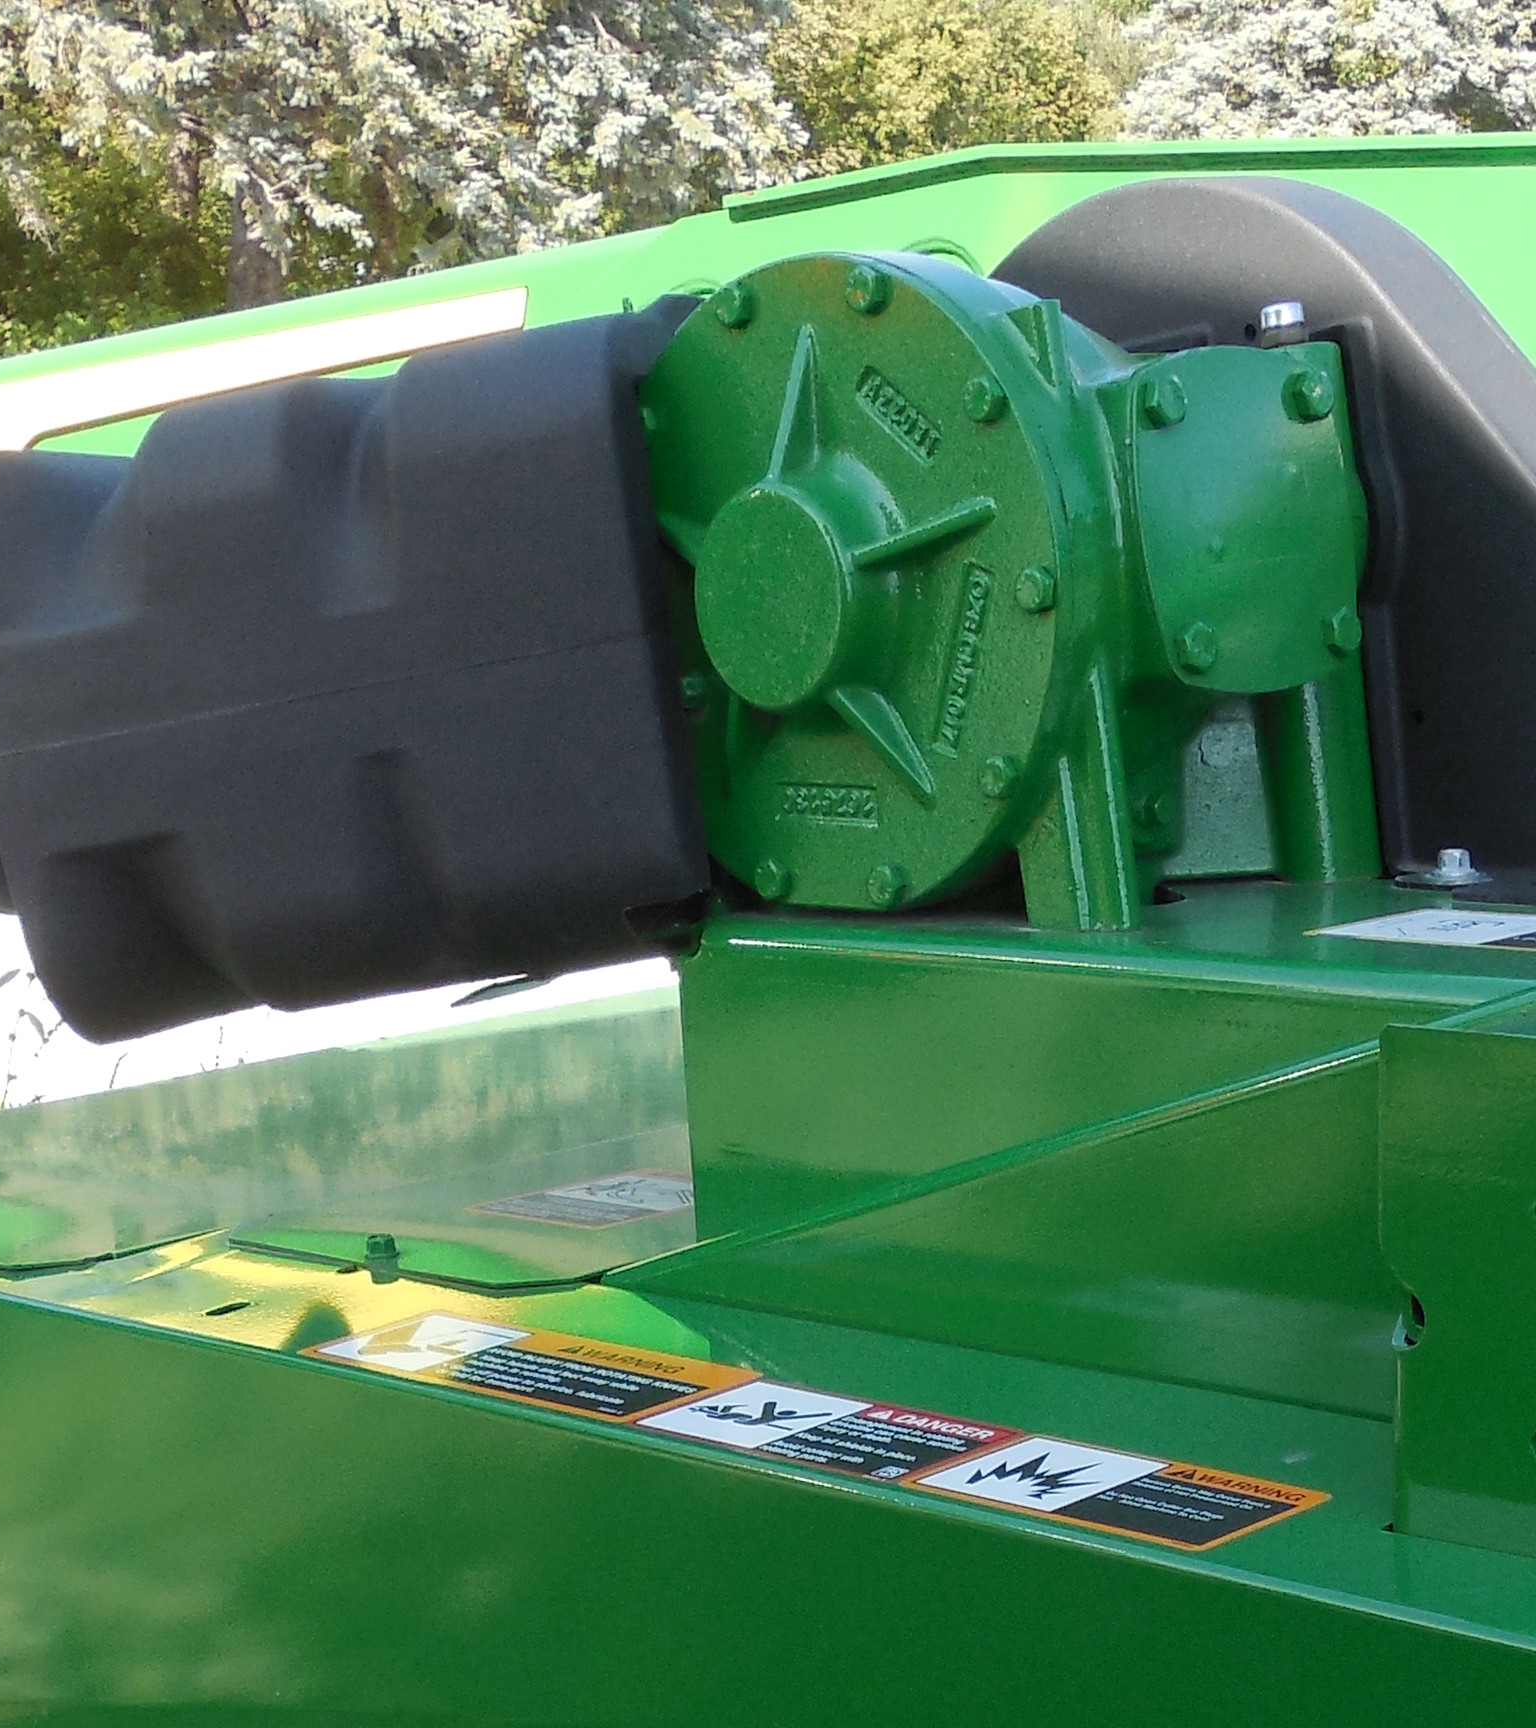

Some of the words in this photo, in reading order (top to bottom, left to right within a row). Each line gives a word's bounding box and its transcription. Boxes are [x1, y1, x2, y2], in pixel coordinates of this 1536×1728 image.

[583, 1348, 686, 1375] WARNING
[893, 1414, 994, 1440] DANGER
[1198, 1473, 1306, 1504] WARNING
